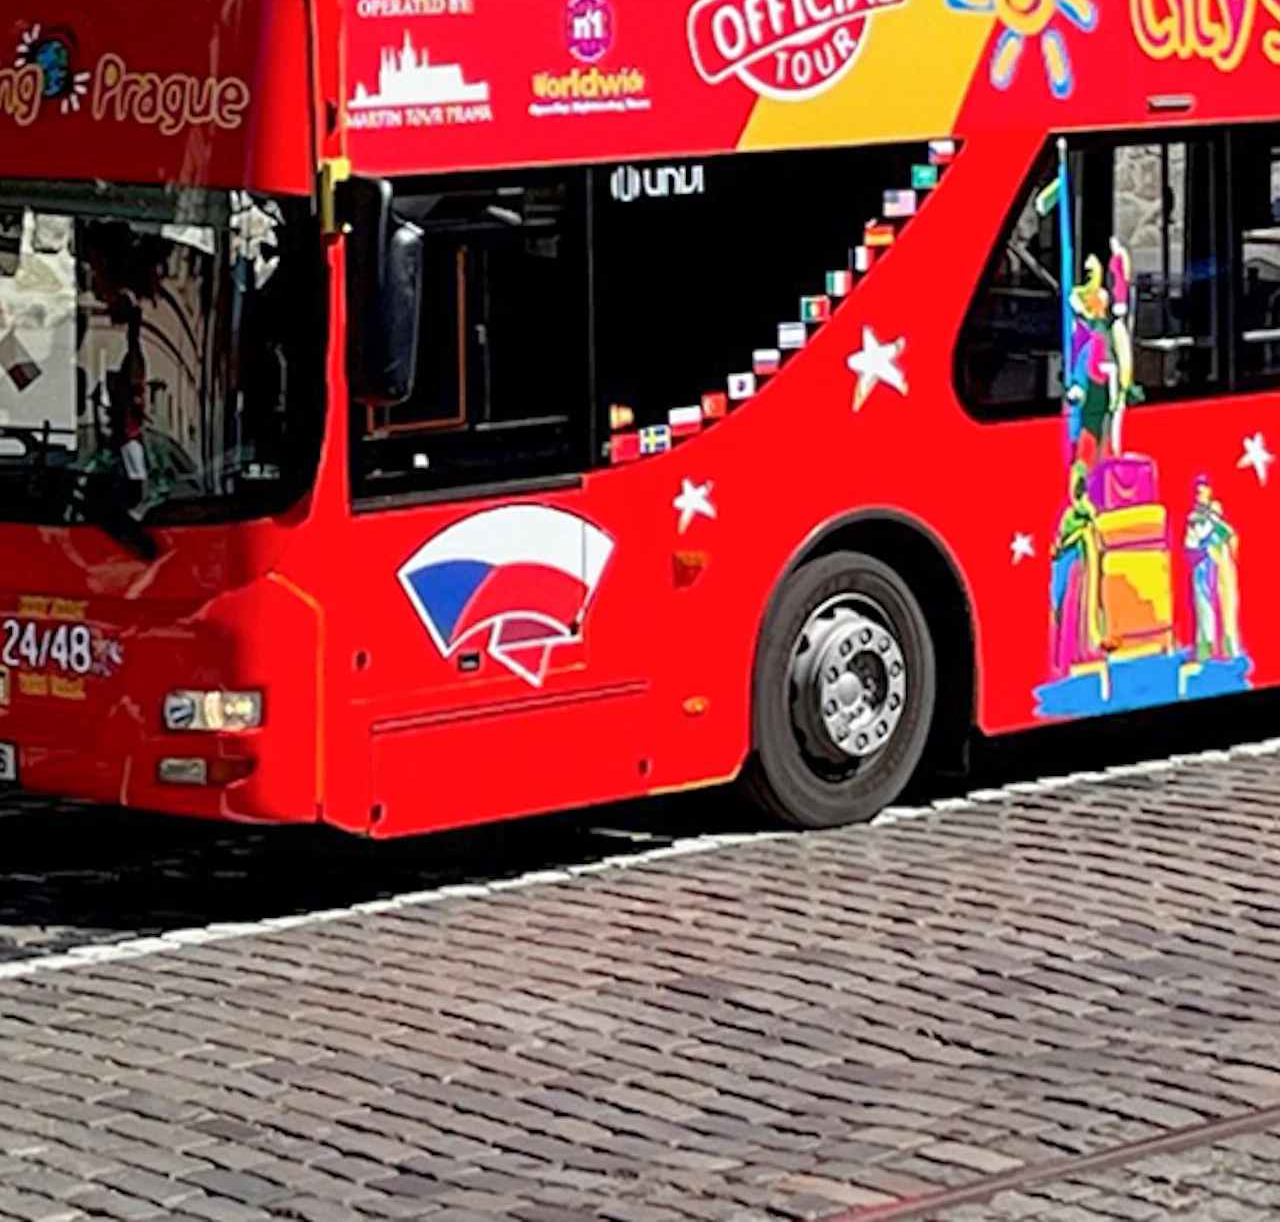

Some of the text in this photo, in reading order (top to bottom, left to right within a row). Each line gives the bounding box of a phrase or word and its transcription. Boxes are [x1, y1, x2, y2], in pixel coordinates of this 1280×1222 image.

[775, 28, 857, 84] TOUR
[92, 52, 250, 136] Prague
[2, 619, 92, 673] 24/48
